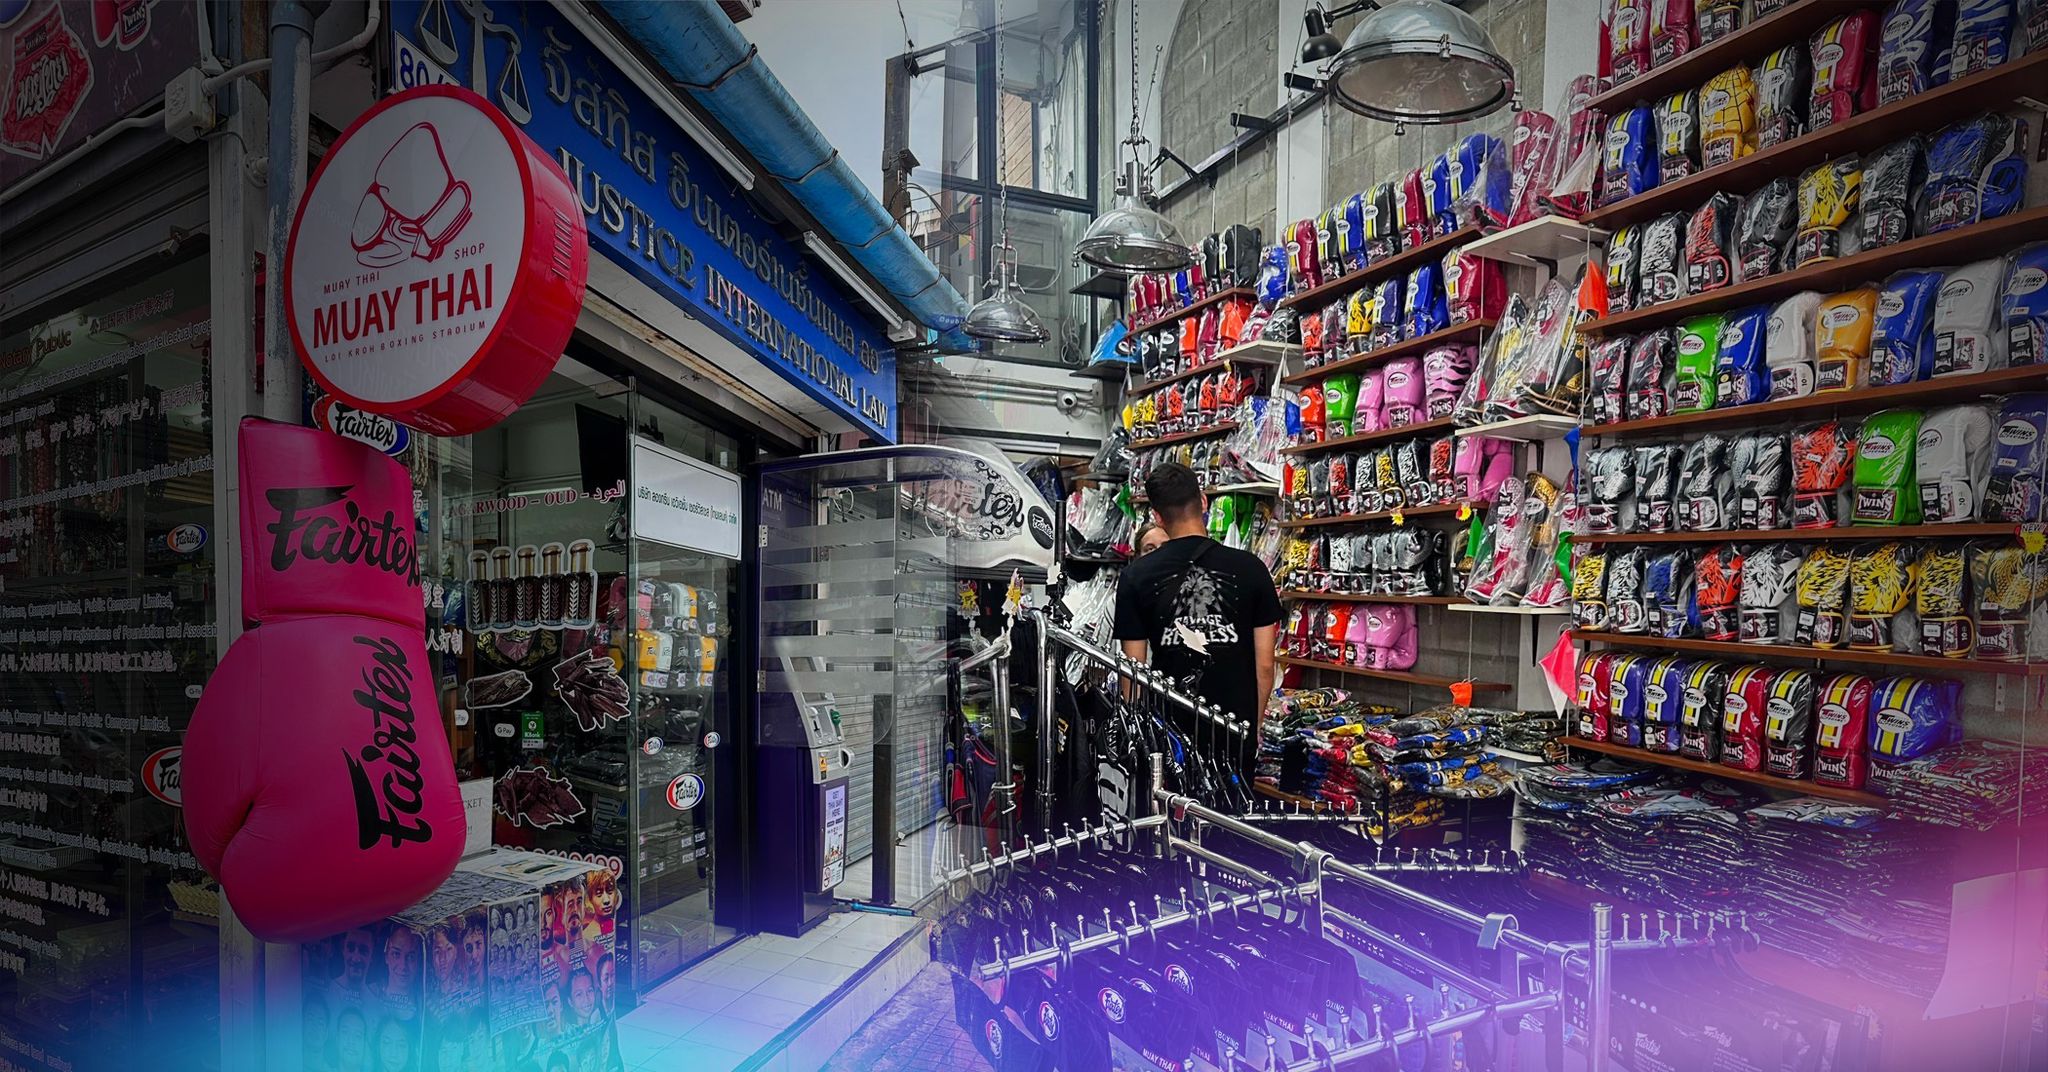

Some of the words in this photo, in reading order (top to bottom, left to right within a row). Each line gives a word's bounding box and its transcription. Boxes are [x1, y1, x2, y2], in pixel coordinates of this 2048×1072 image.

[1662, 163, 1688, 184] TWINS
[454, 242, 485, 260] SHOP
[323, 278, 351, 294] MUAY
[356, 272, 380, 287] THAI
[313, 286, 403, 349] MUAY
[409, 263, 493, 325] THAI
[325, 351, 341, 363] LOI
[349, 345, 375, 358] KROH
[380, 334, 424, 351] BOXING
[432, 320, 486, 340] STADIUM
[705, 264, 858, 409] INTERNATIONAL
[861, 386, 889, 429] LAW
[1817, 368, 1844, 387] TWINS
[1676, 385, 1700, 401] TWINS
[335, 402, 394, 446] Fairtex
[451, 496, 526, 517] AGARWOOD
[544, 489, 577, 506] OUD
[763, 487, 783, 512] ATM
[1858, 492, 1893, 512] TWINS
[266, 484, 420, 587] Fairtex
[107, 596, 141, 613] Company
[142, 592, 175, 610] Limited,
[165, 623, 182, 638] and
[1850, 623, 1873, 640] TWINS
[1977, 630, 2008, 646] TWINS
[342, 636, 433, 850] Fairtex
[1767, 750, 1793, 766] TWINS
[1817, 759, 1846, 777] TWINS
[676, 780, 698, 804] Fairtex
[1143, 1048, 1159, 1064] MUAY
[1159, 1056, 1176, 1072] THAI
